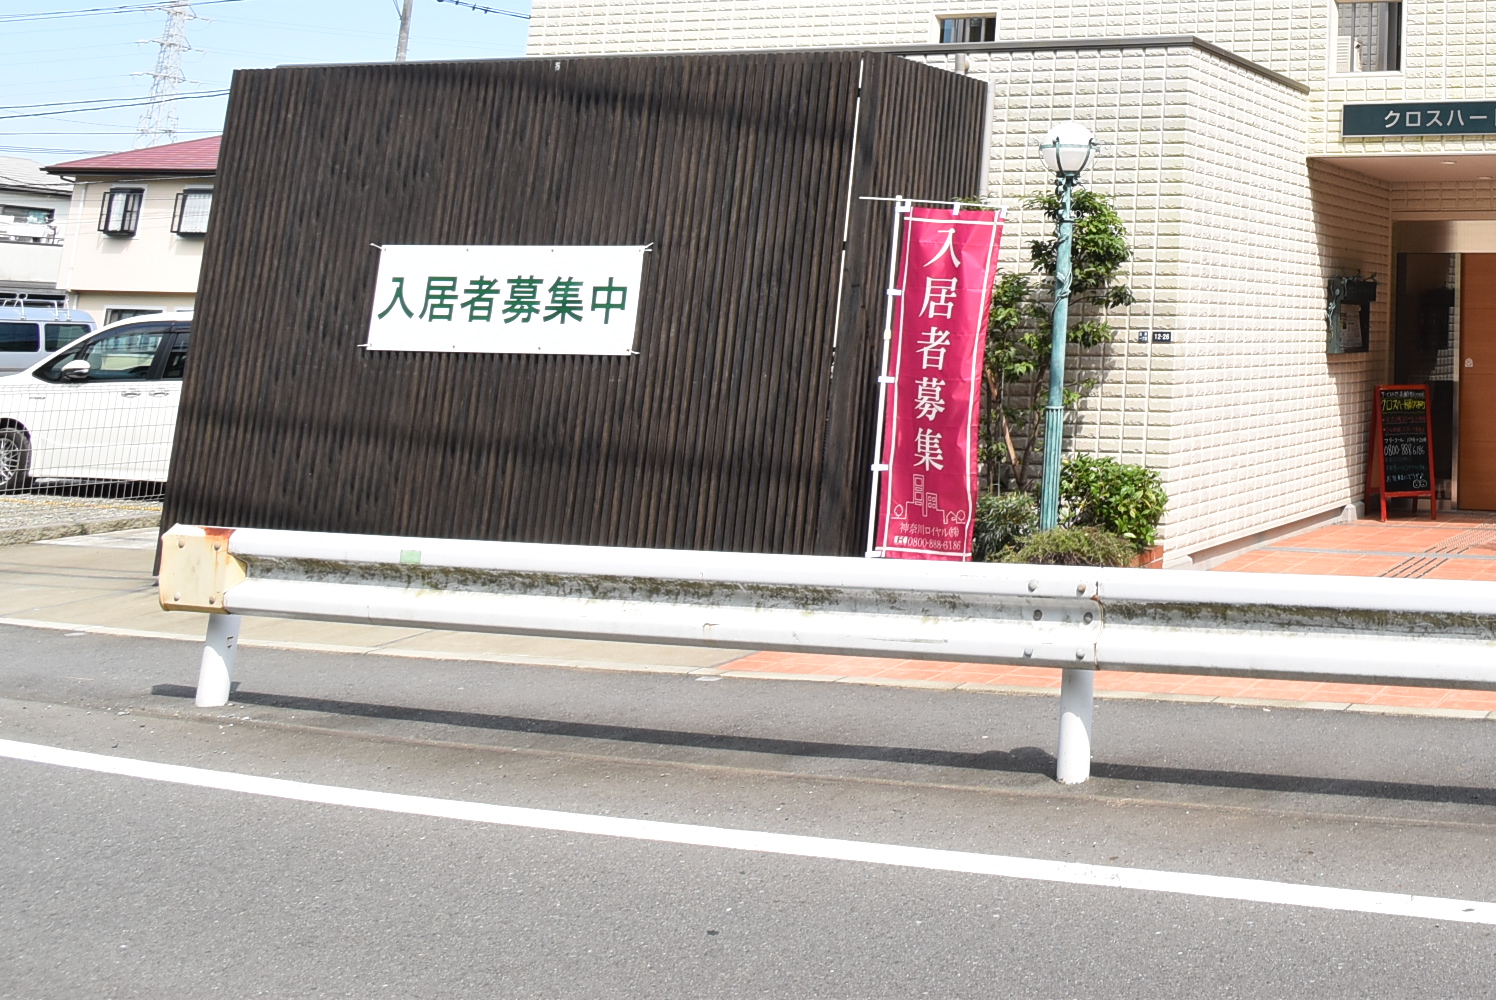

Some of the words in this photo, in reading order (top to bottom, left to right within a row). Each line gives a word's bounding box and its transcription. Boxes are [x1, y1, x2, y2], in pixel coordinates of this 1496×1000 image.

[377, 275, 628, 325] 入居者募集中
[914, 228, 961, 471] 入居者募集
